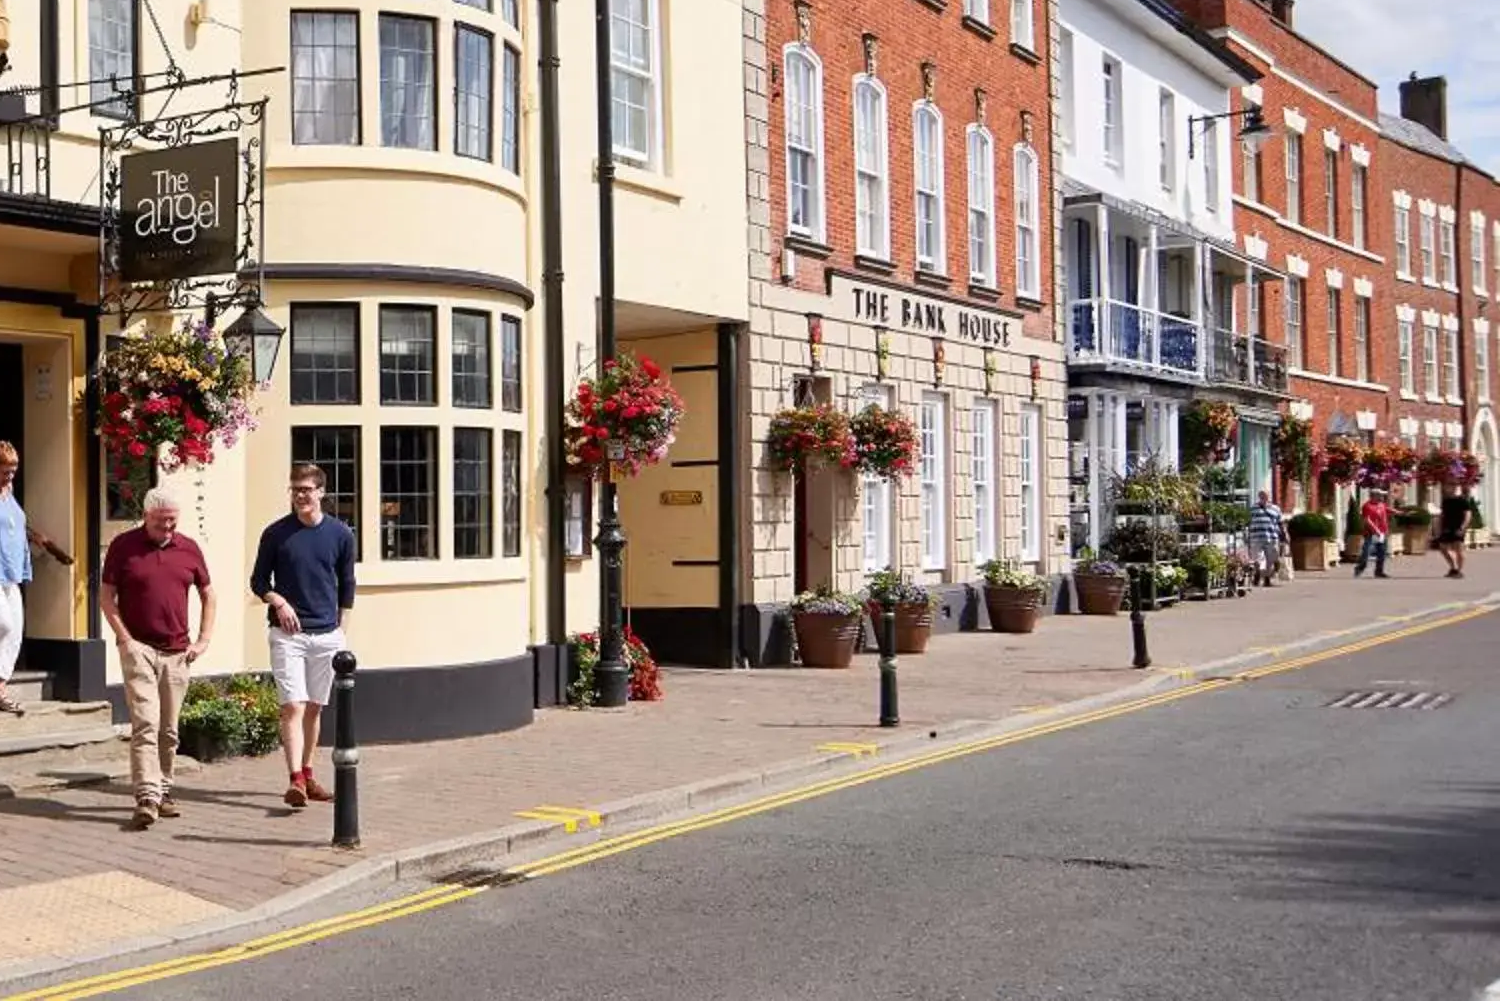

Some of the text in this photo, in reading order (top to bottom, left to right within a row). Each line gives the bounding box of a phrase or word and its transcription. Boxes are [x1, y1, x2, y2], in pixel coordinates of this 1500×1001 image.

[135, 175, 220, 245] angel
[151, 169, 189, 195] The
[852, 287, 1011, 348] THE BANK HOUSE
